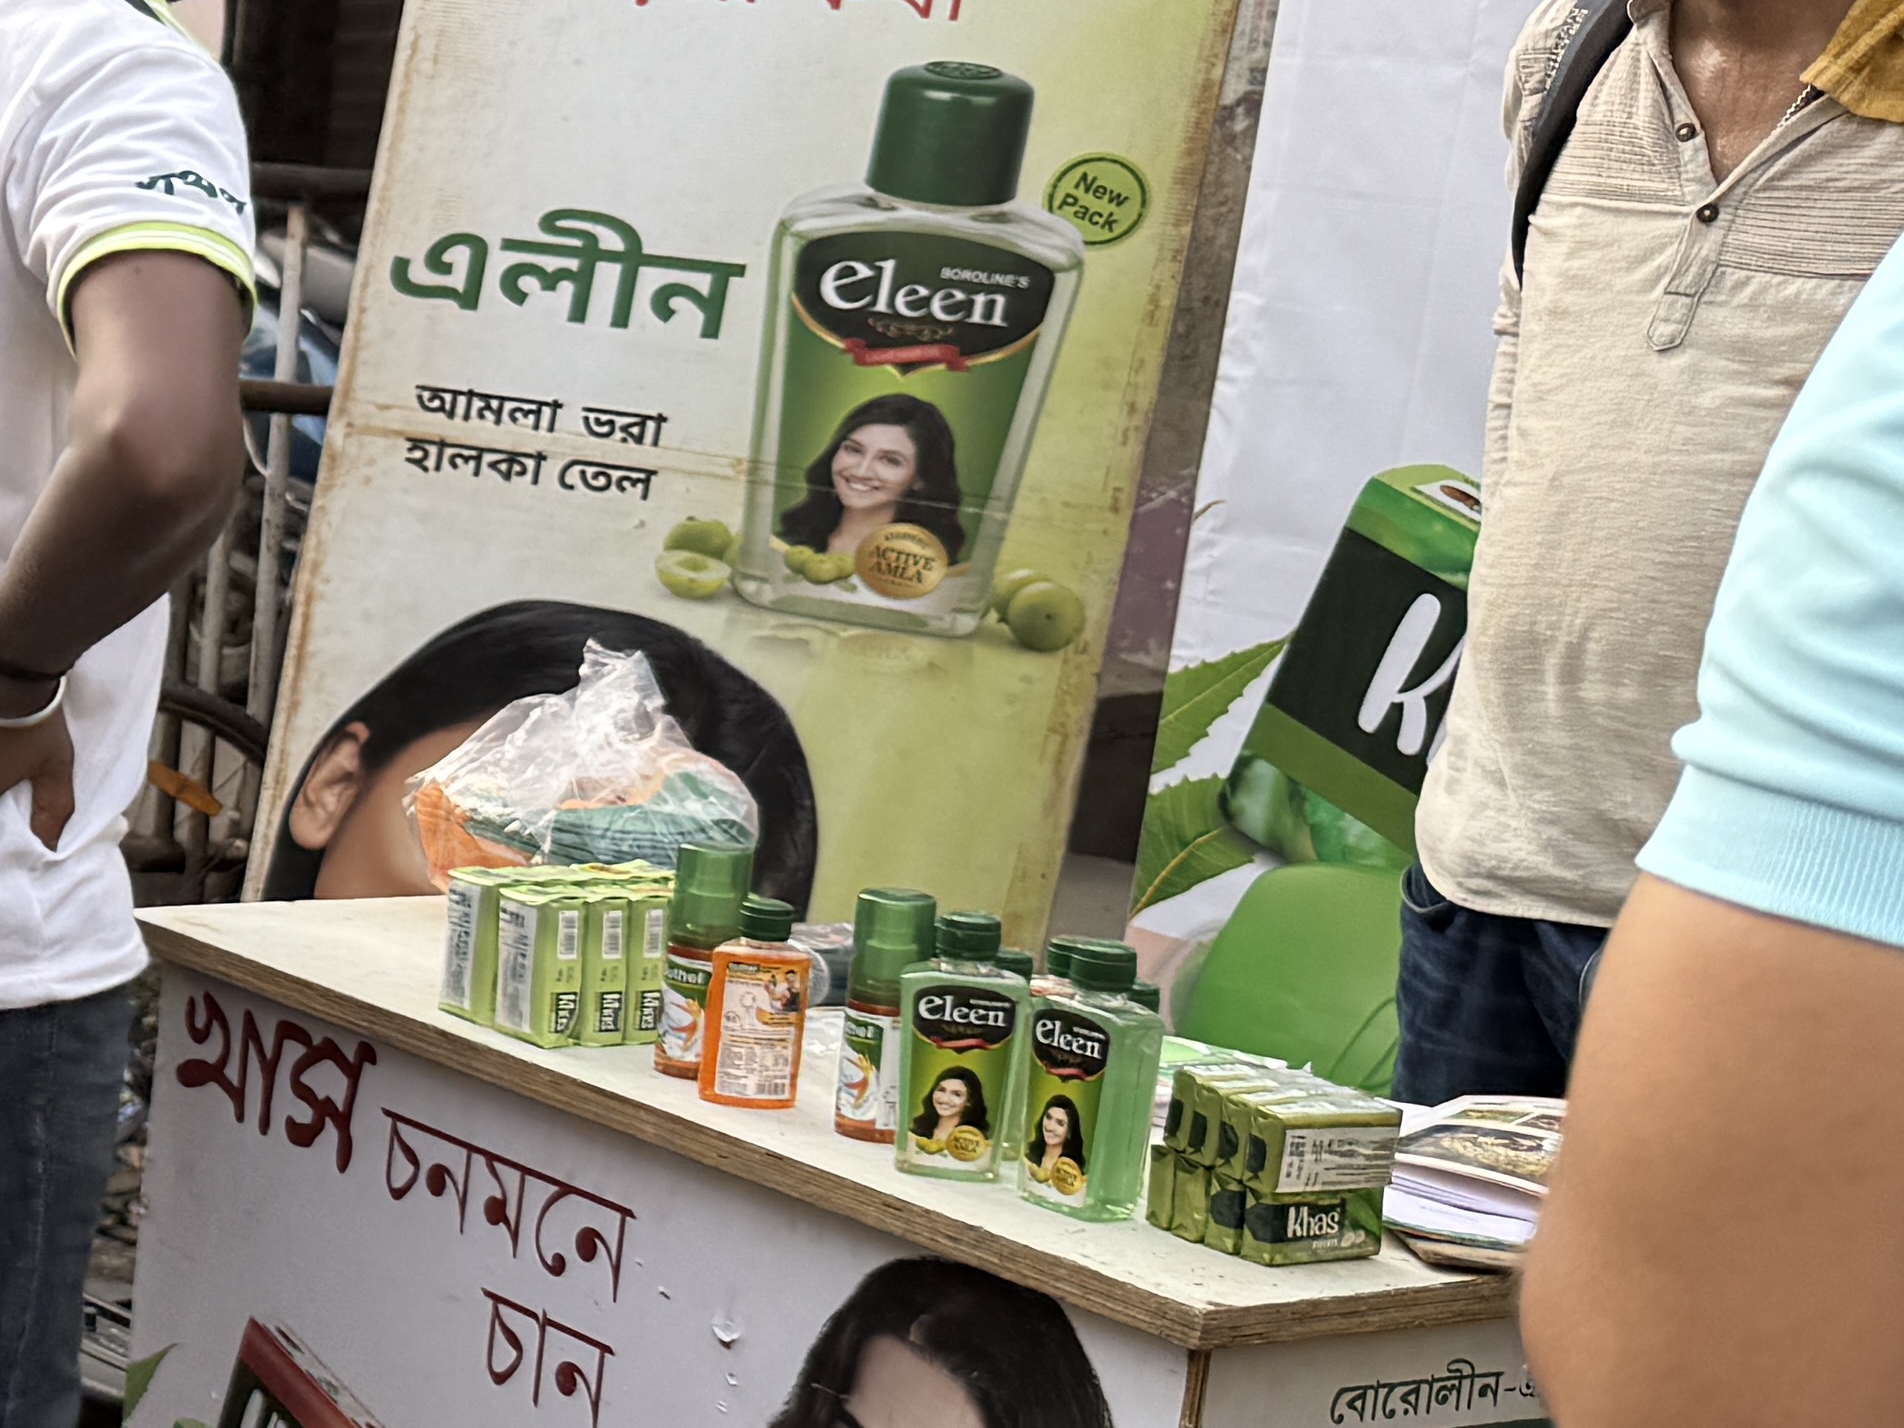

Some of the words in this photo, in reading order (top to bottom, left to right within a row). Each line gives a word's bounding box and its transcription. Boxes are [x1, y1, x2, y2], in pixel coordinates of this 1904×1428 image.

[1073, 171, 1131, 209] New
[1056, 193, 1120, 234] Pack
[390, 209, 746, 341] এলীন
[940, 267, 1031, 289] BOROLINE'S
[415, 384, 562, 434] আমলা
[583, 402, 668, 449] ভরা
[404, 435, 546, 490] হালকা
[557, 452, 658, 502] তেল
[868, 561, 923, 584] AMLA
[870, 545, 936, 572] ACTIVE
[382, 1106, 637, 1303] চনমনে
[1287, 1205, 1340, 1238] Khas
